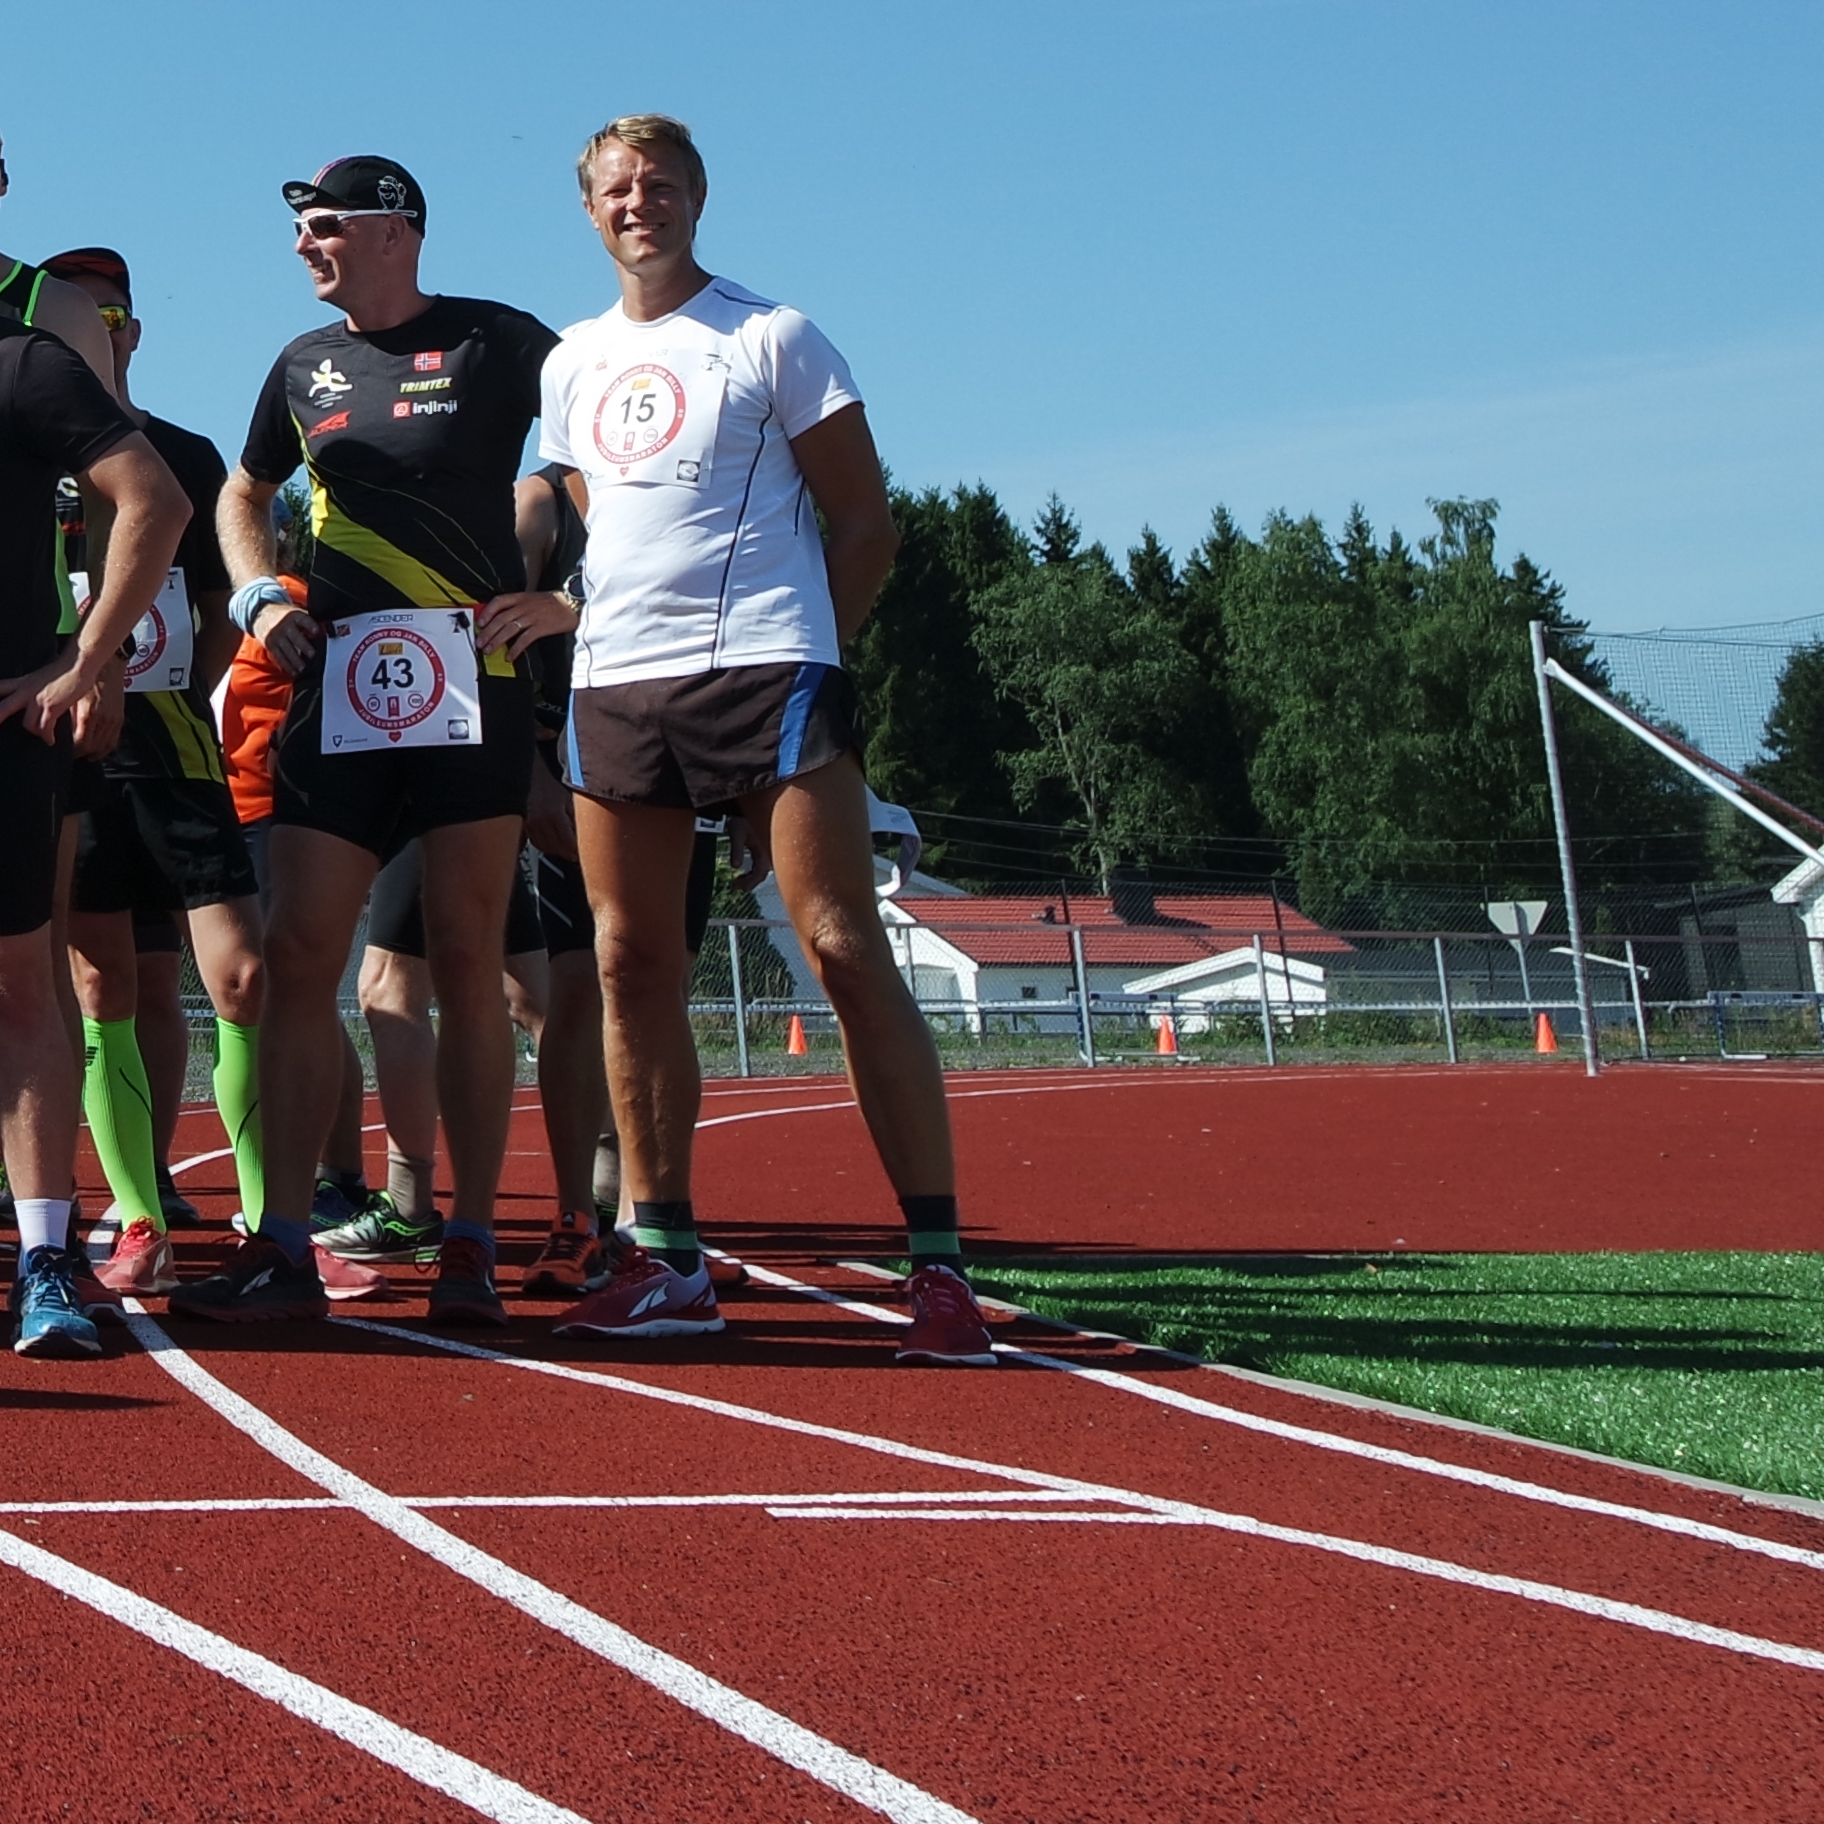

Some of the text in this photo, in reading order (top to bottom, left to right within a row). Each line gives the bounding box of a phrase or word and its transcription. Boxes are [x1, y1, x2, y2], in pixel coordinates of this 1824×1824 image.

[400, 377, 452, 393] TRIMTEX
[654, 366, 666, 377] JAN
[666, 375, 681, 394] BILLY
[413, 400, 458, 415] injinji
[620, 394, 657, 424] 15
[368, 614, 413, 625] ASCENDER
[353, 643, 365, 662] TEAM
[365, 632, 388, 643] RONNY
[403, 633, 418, 643] JAN
[418, 639, 436, 658] BILLY
[371, 658, 414, 690] 43
[359, 702, 435, 728] JUBILEUMSMARATON
